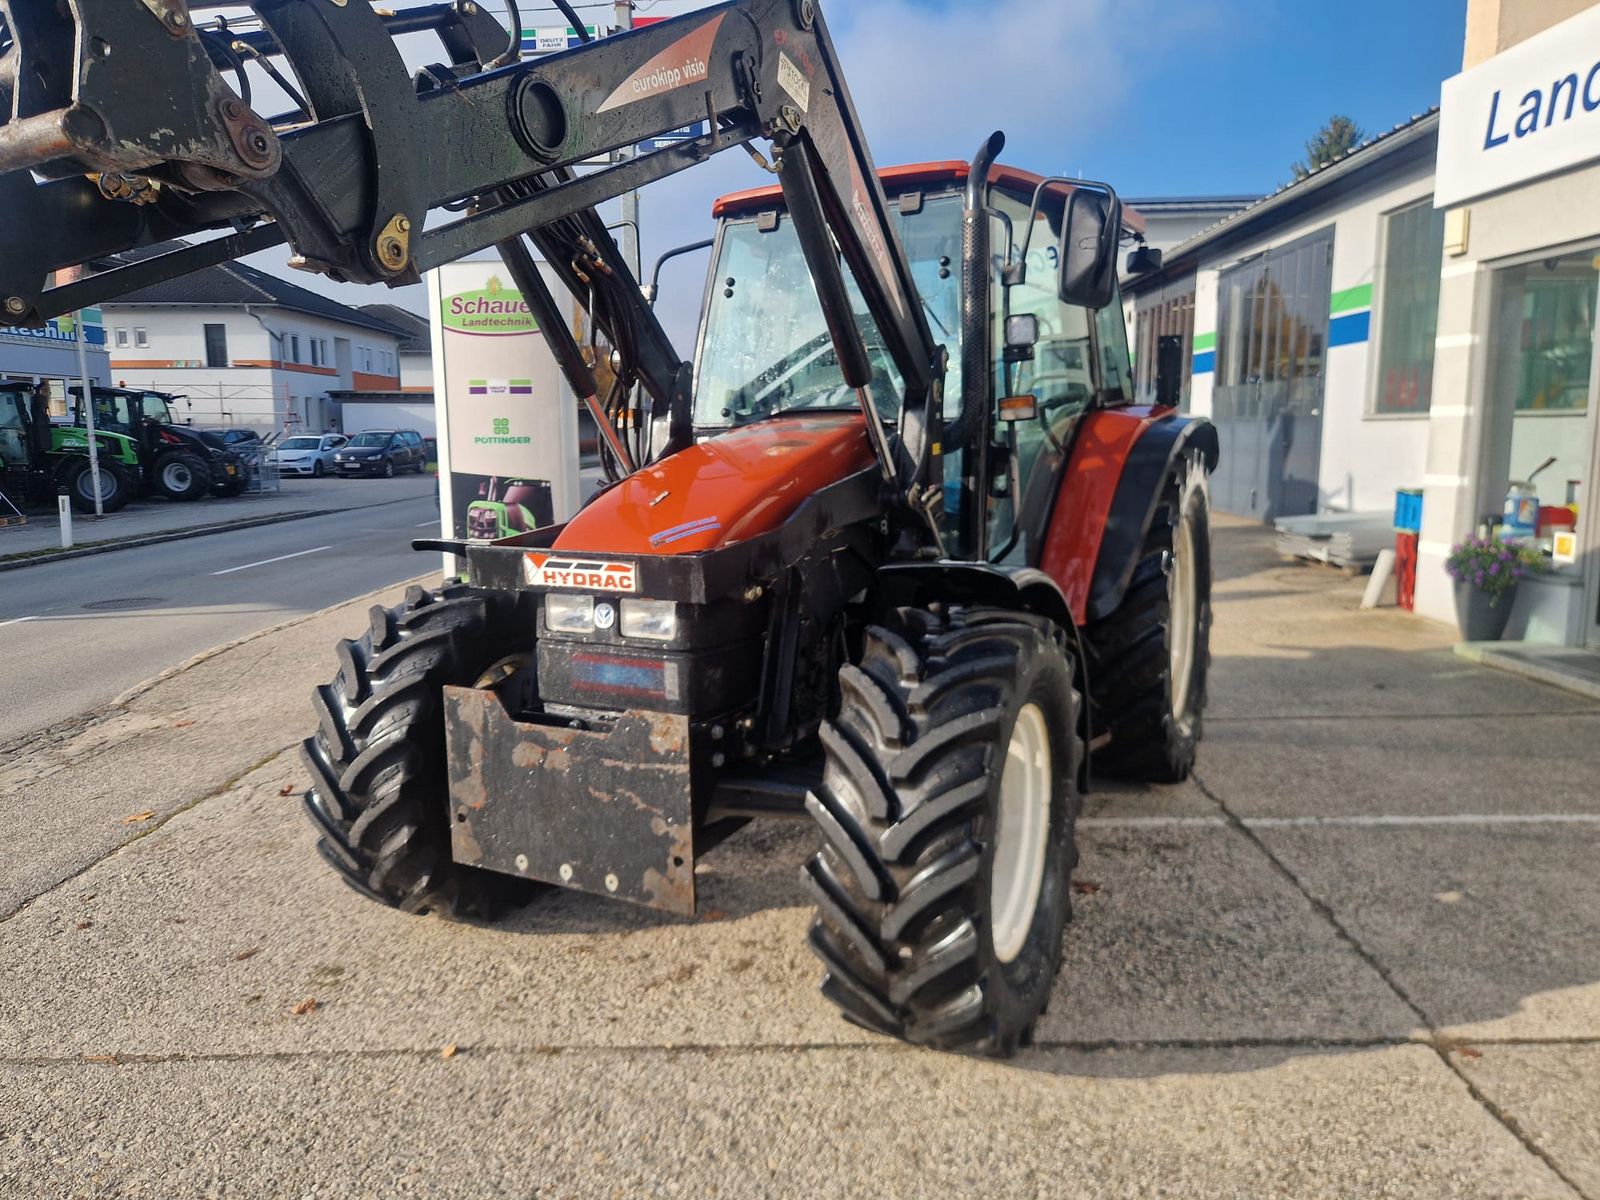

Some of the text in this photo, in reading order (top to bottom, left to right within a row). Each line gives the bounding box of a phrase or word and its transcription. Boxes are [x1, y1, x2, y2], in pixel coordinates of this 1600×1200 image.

[632, 57, 706, 93] eurokipp visio
[450, 296, 531, 315] Schaue
[462, 317, 532, 327] Landtechnik
[543, 571, 632, 588] HYDRAC
